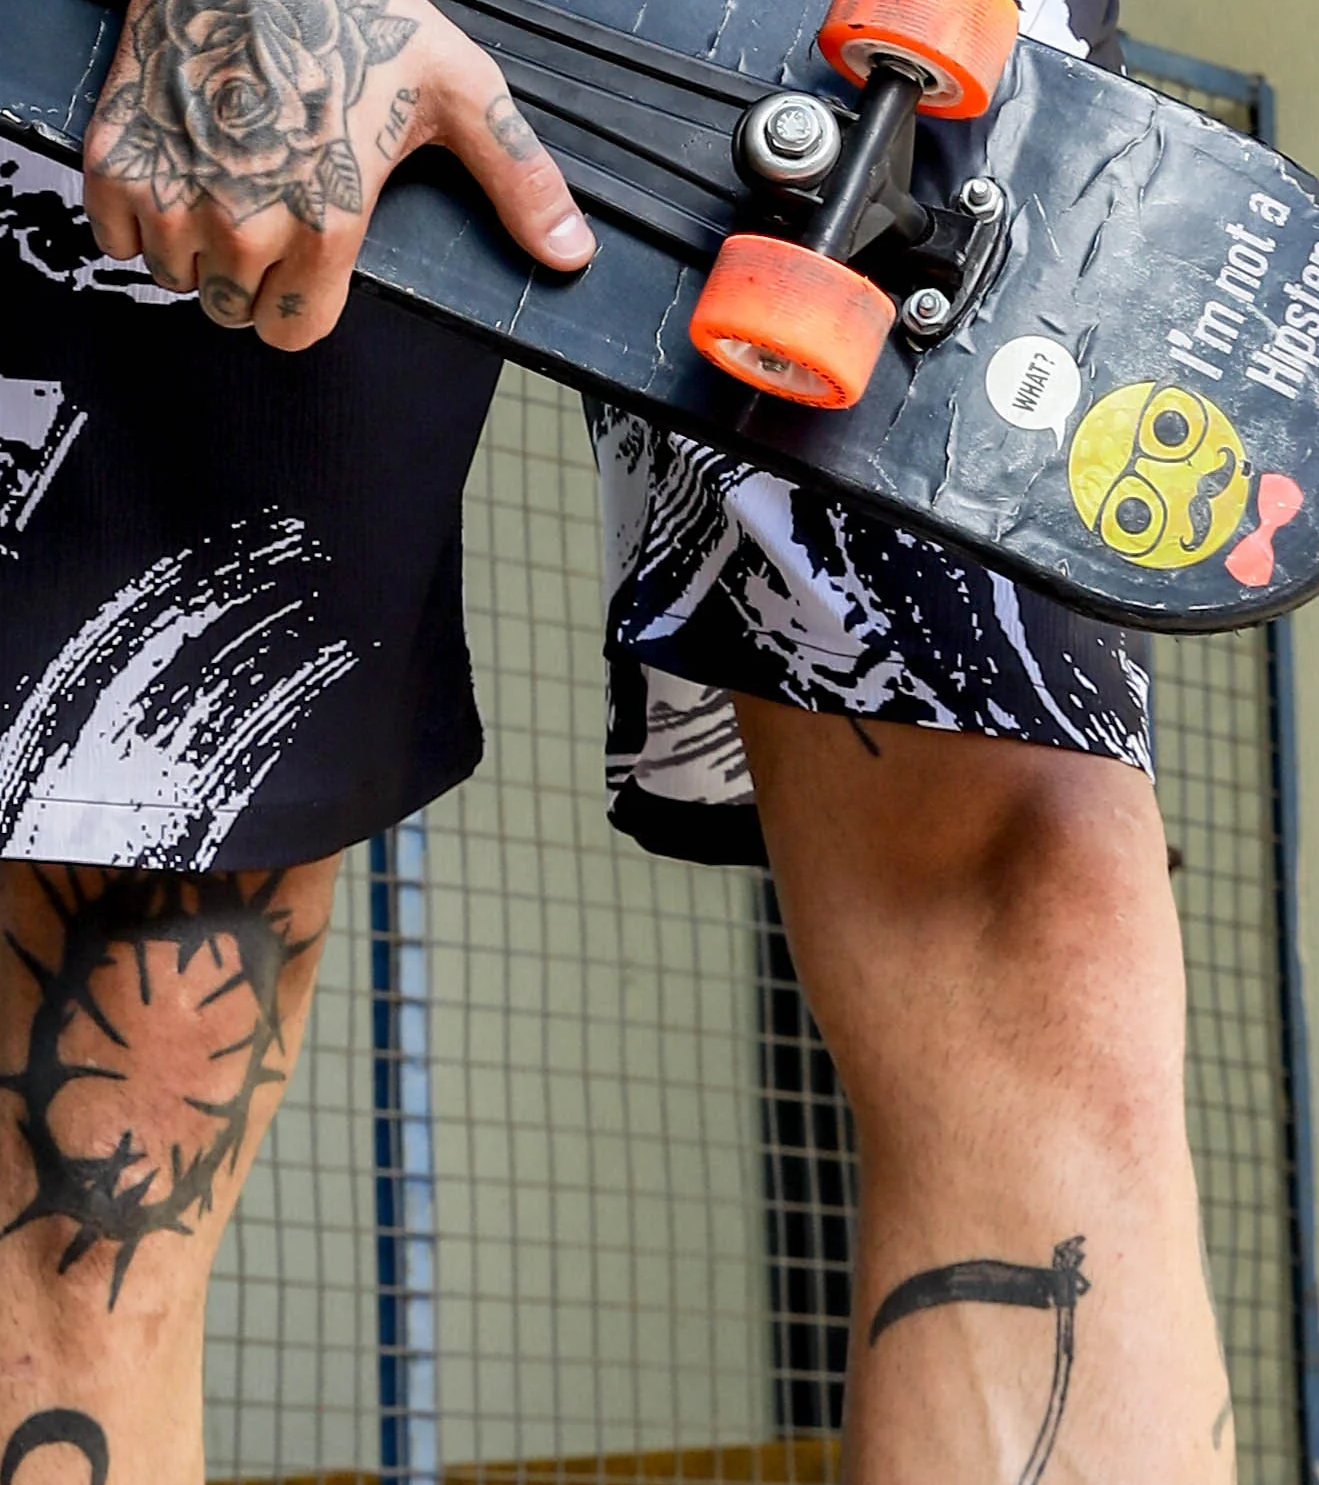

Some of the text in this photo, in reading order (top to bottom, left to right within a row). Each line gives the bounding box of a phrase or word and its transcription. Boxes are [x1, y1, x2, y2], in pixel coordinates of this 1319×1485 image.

[1166, 191, 1292, 381] I'm not a
[1011, 352, 1056, 412] WHAT?
